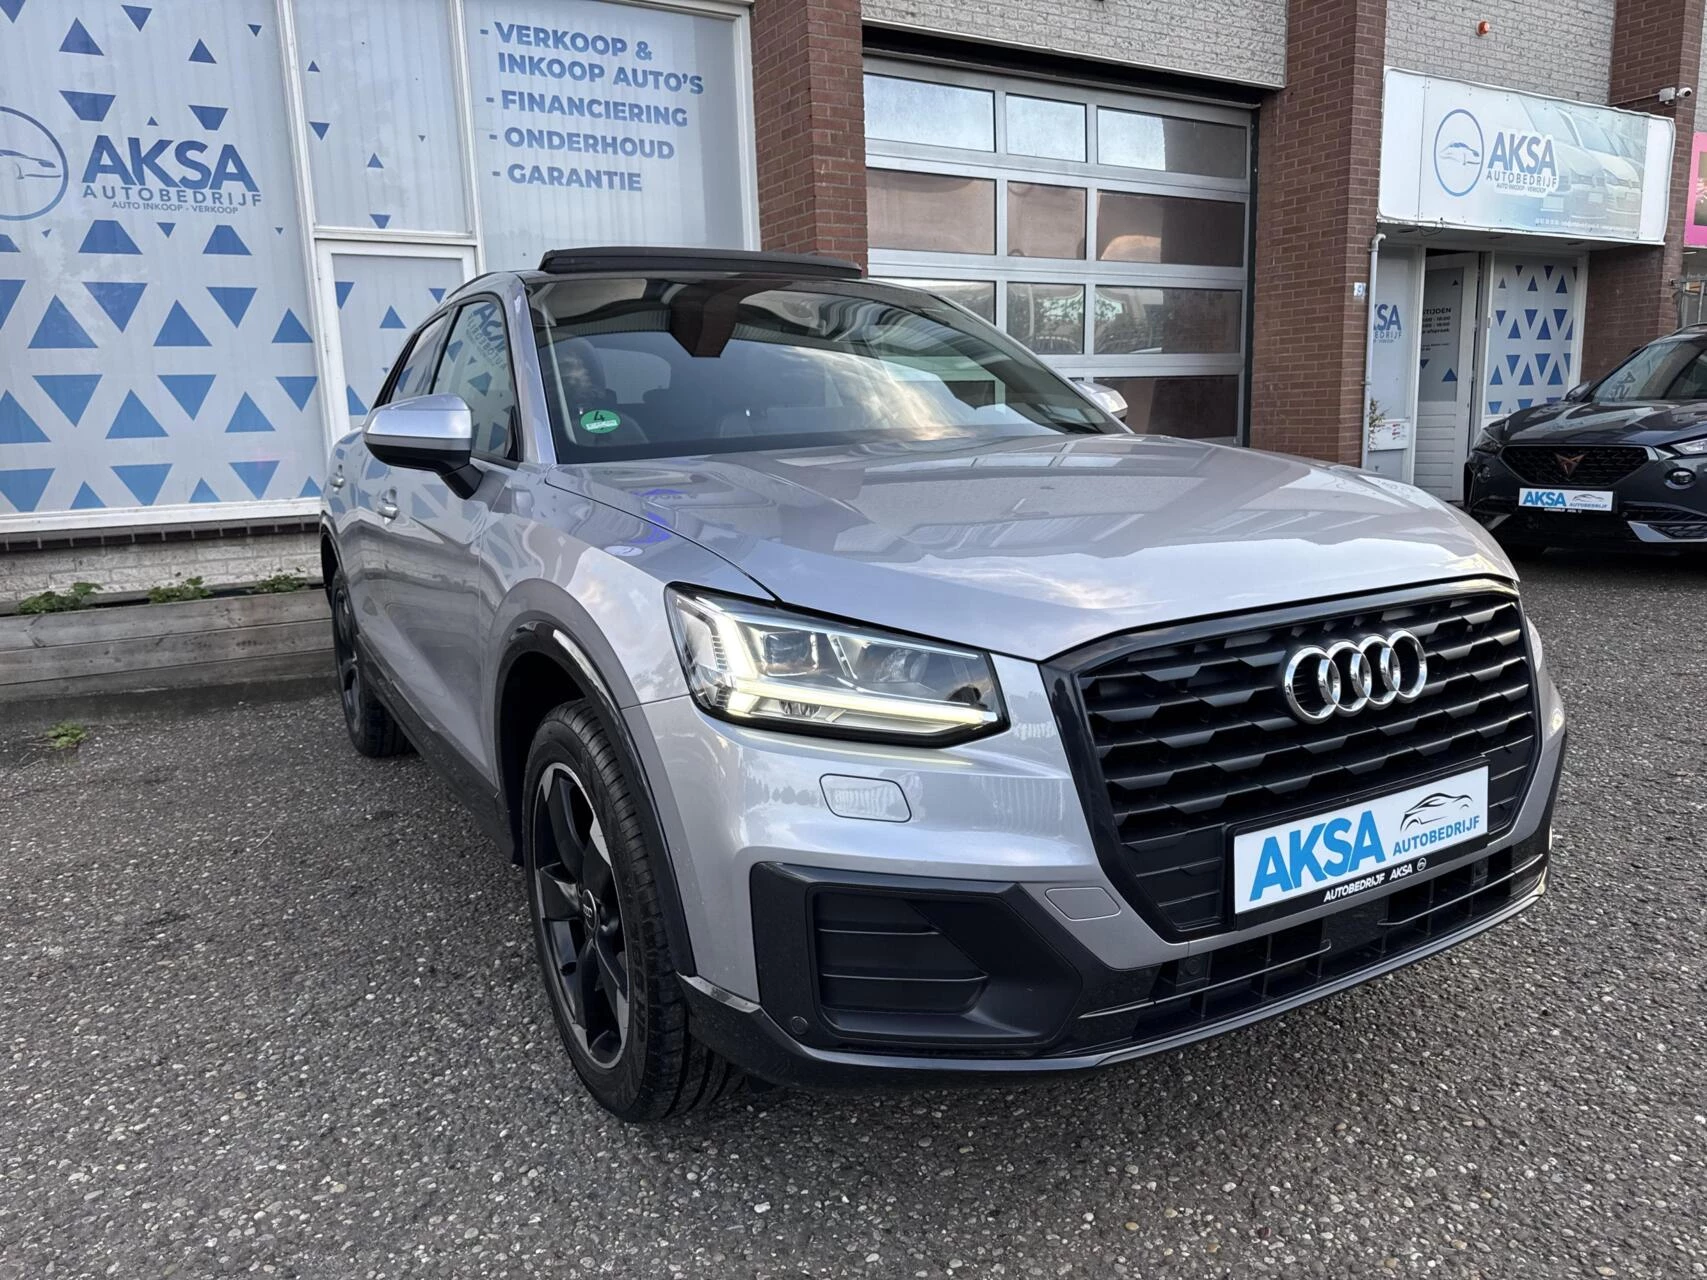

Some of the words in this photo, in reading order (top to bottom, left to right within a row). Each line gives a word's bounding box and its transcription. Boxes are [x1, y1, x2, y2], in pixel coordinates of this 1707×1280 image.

[494, 22, 627, 56] VERKOOP
[635, 40, 652, 60] &
[498, 52, 605, 82] INKOOP
[613, 67, 704, 95] AUTO'S
[501, 90, 688, 127] FINANCIERING
[504, 126, 675, 160] ONDERHOUD
[1487, 132, 1557, 177] AKSA
[82, 135, 260, 192] AKSA
[507, 163, 643, 192] GARANTIE
[1486, 170, 1557, 188] AUTOBEDRIJF
[82, 185, 262, 207] AUTOBEDRIJF
[112, 201, 140, 210] AUTO
[143, 202, 183, 212] INKOOP
[191, 205, 239, 215] VERKOOP
[1522, 491, 1567, 507] AKSA
[1393, 815, 1481, 857] AUTOBEDRIJF
[1249, 810, 1386, 902] AKSA
[1324, 873, 1385, 902] AUTOBEDRIJF
[1389, 863, 1413, 881] AKSA
